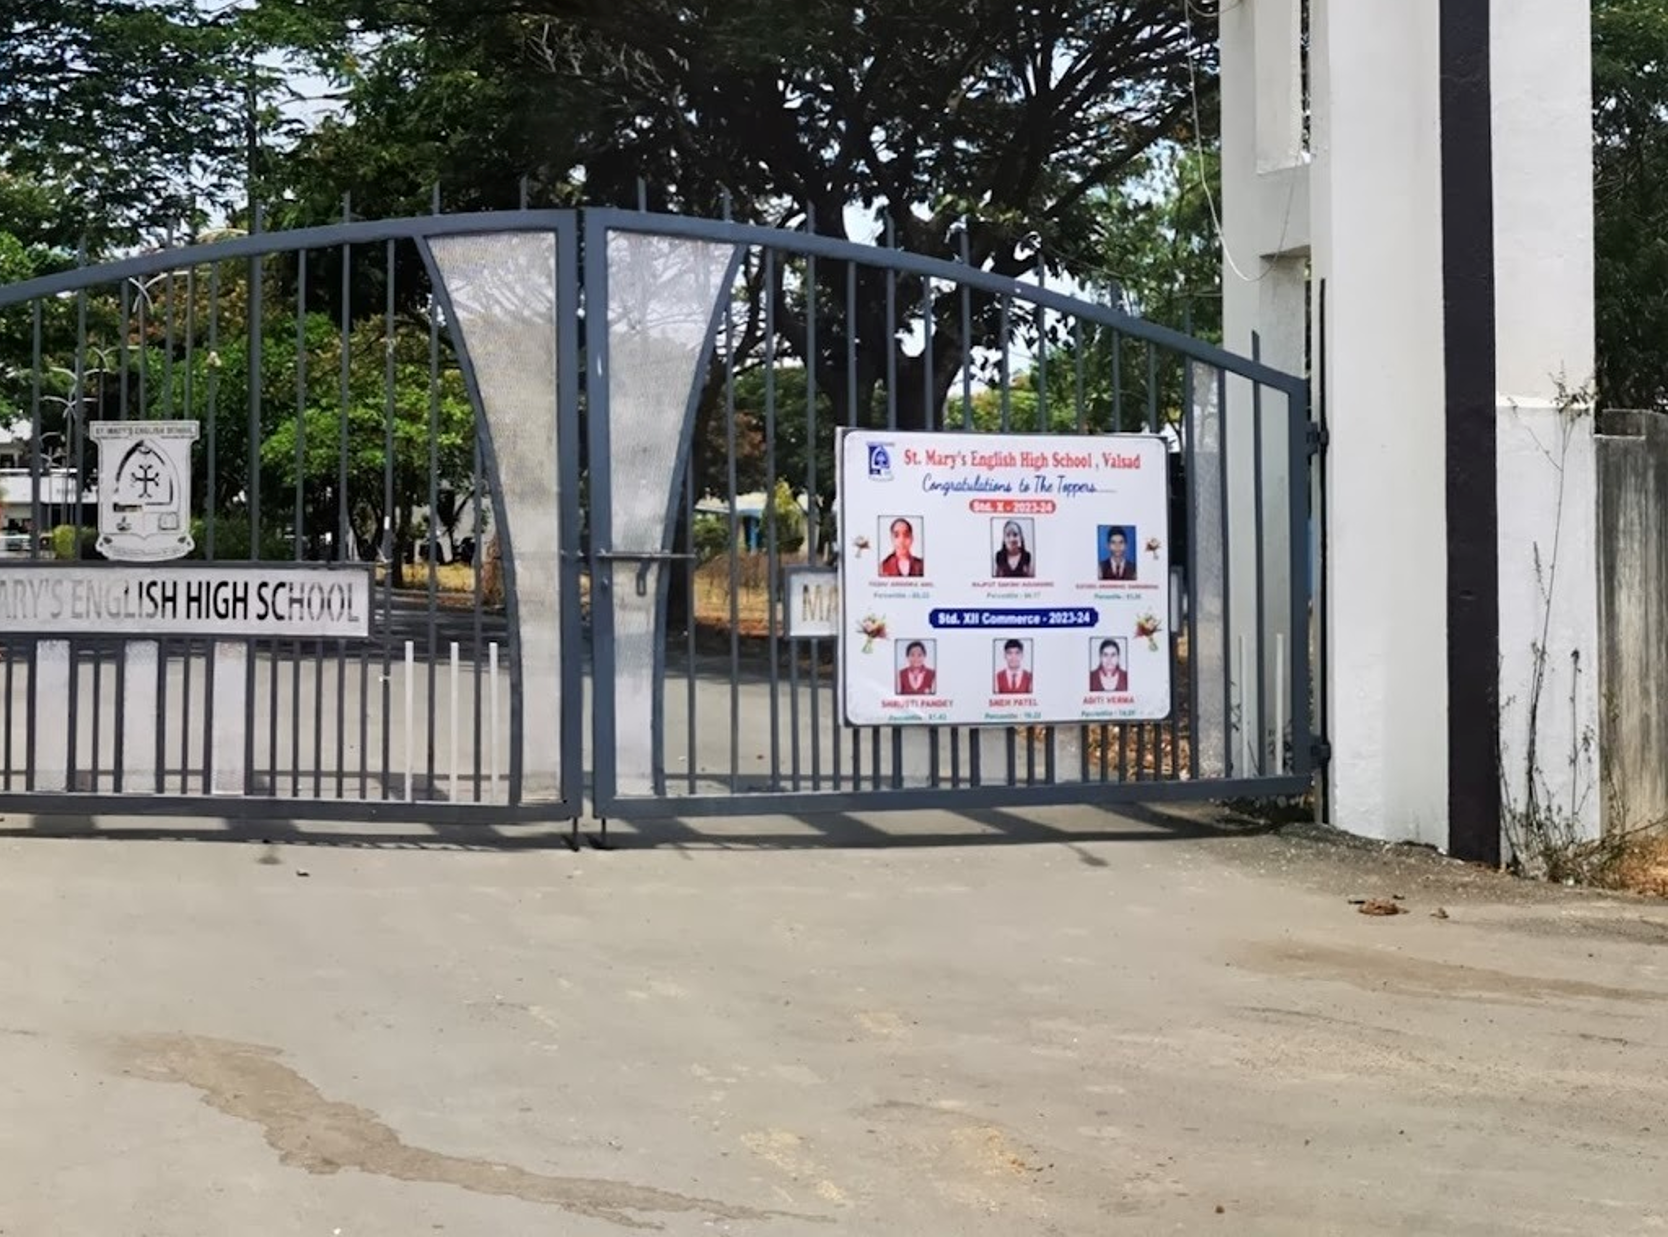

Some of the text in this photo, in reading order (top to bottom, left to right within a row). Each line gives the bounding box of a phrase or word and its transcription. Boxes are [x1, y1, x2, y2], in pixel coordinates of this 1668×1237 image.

[904, 448, 922, 465] St.
[925, 448, 967, 470] Mary's
[970, 450, 1017, 471] English
[1020, 451, 1049, 471] High
[1052, 451, 1093, 468] School
[1102, 452, 1141, 469] Valsad
[922, 473, 1012, 496] Congratulations
[1034, 474, 1052, 493] The
[70, 578, 178, 620] ENGLISH
[186, 580, 249, 620] HIGH
[256, 580, 360, 623] SCHOOL
[938, 612, 960, 624] Std.
[982, 612, 1041, 625] Commerce
[1049, 610, 1091, 623] 2023-24
